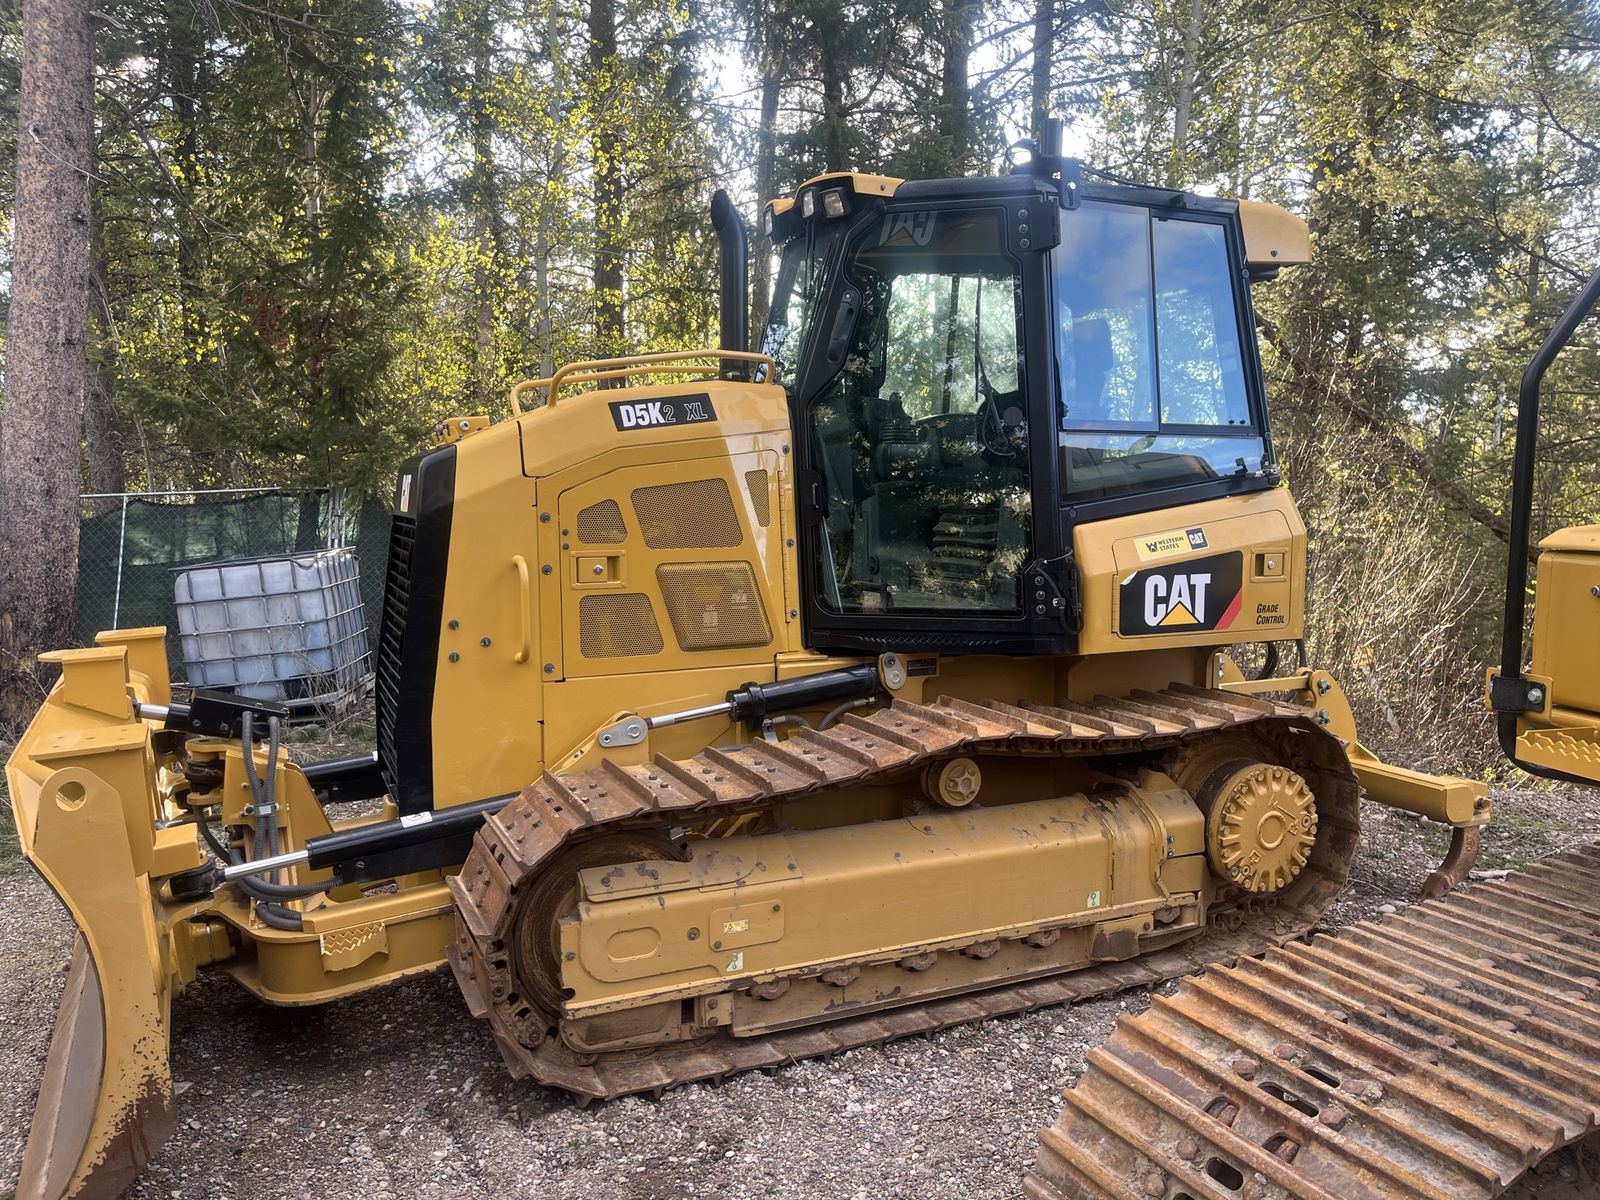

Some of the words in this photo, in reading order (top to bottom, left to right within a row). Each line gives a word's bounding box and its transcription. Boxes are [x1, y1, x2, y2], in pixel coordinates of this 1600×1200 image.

[620, 402, 676, 428] D5K2
[684, 402, 708, 421] XL
[1158, 536, 1185, 545] WESTERN
[1188, 532, 1205, 545] CAT
[1160, 543, 1180, 551] STATES
[1144, 573, 1211, 627] CAT
